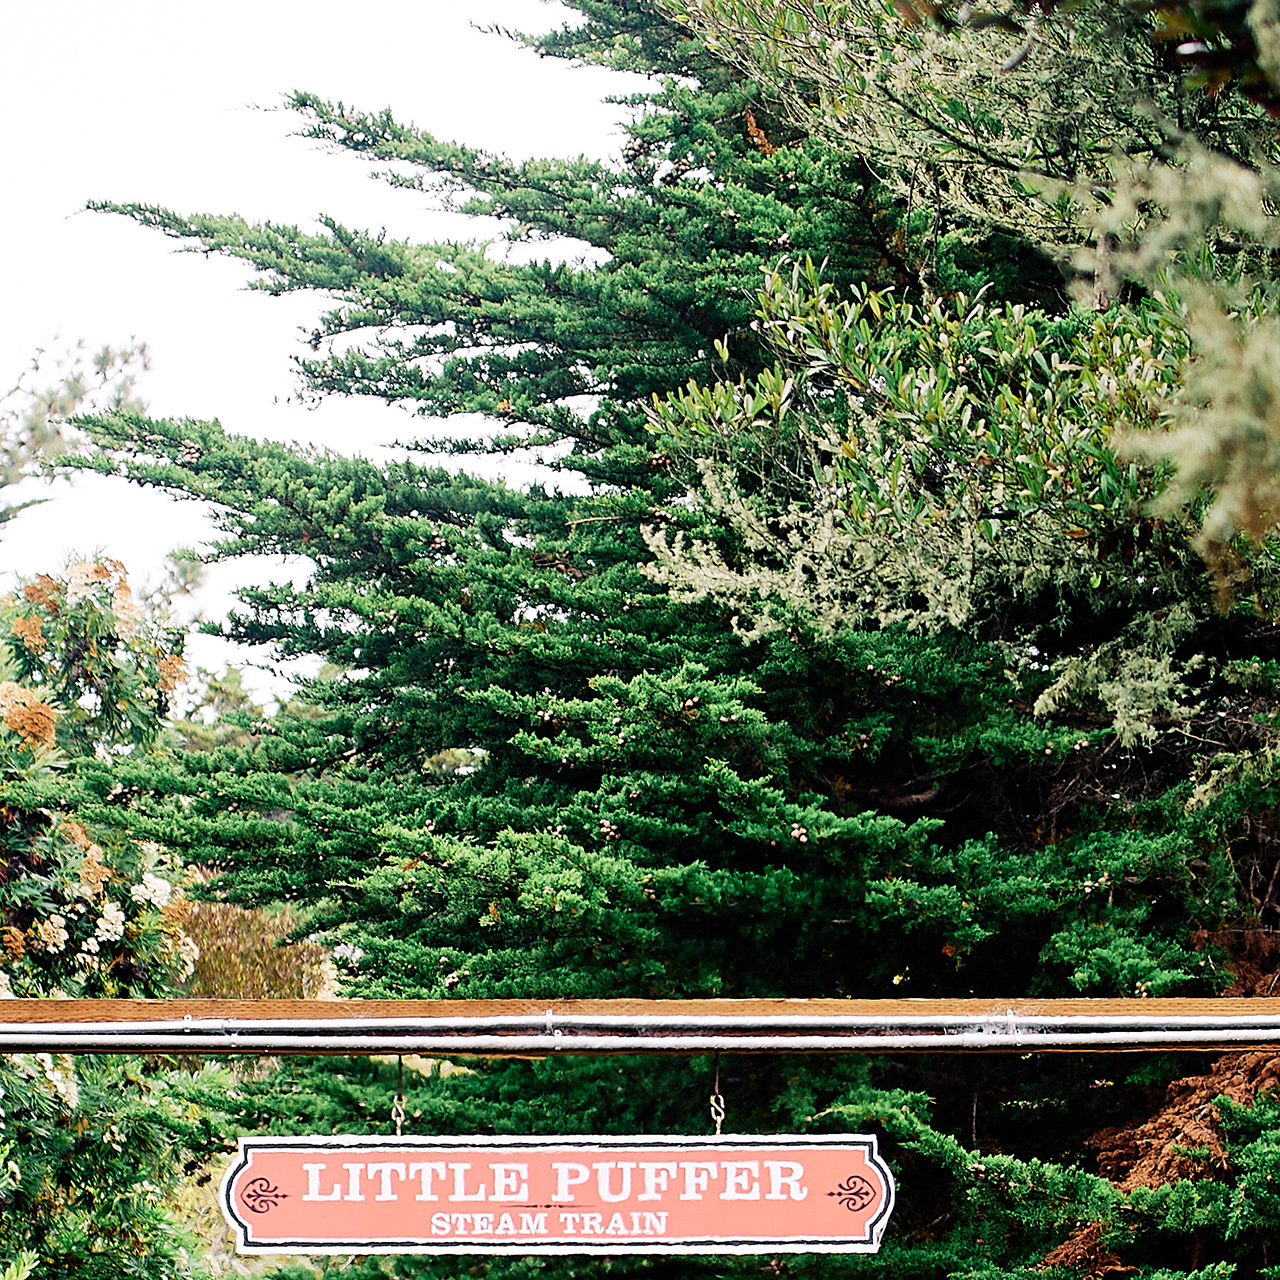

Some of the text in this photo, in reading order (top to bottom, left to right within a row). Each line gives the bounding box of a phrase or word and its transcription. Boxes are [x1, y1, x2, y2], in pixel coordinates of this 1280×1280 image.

[301, 1159, 809, 1202] LITTLE PUFFER
[430, 1210, 669, 1236] STEAM TRAIN
